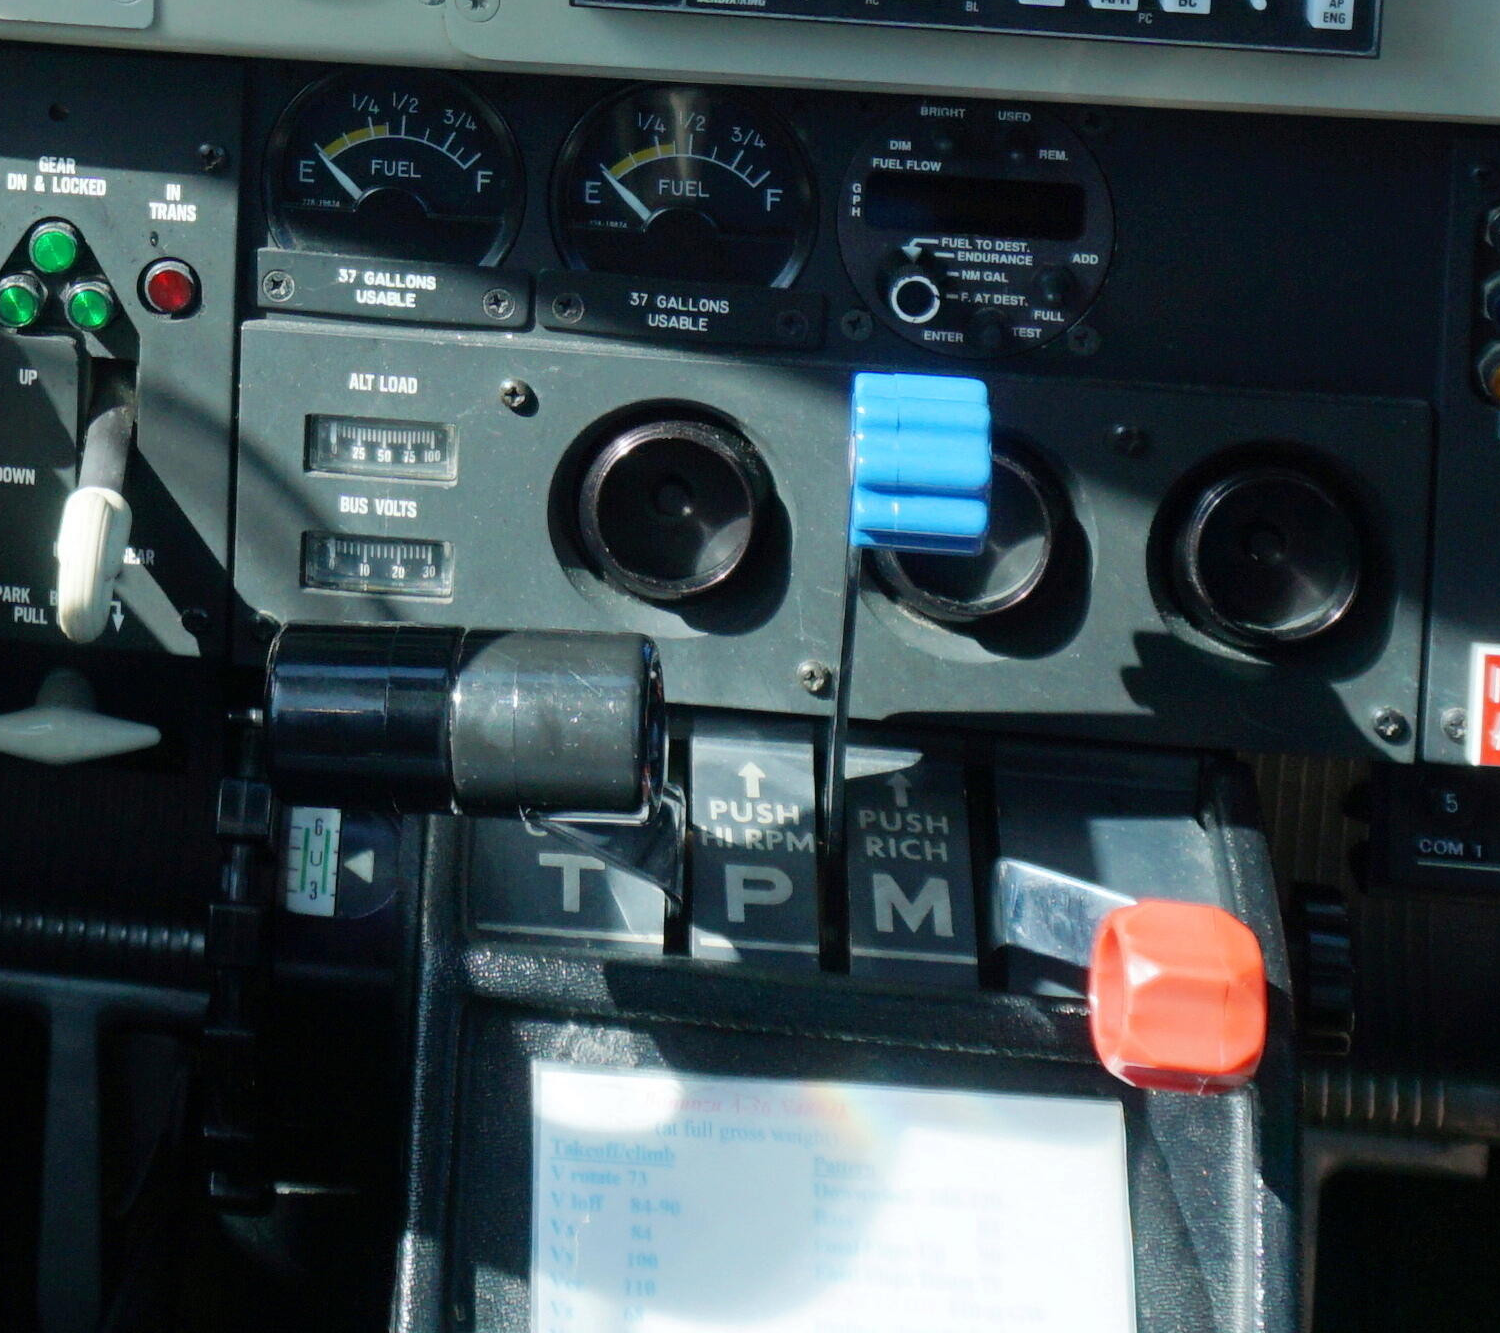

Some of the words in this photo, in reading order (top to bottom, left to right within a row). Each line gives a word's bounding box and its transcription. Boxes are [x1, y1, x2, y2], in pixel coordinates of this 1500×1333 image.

[39, 156, 75, 174] GEAR
[372, 160, 421, 177] FUEL
[8, 173, 27, 191] DN
[34, 175, 45, 191] &
[52, 177, 106, 196] LOCKED
[166, 184, 180, 200] IN
[659, 179, 709, 197] FUEL
[149, 202, 196, 221] TRANS
[338, 269, 357, 284] 37
[364, 271, 436, 290] GALLONS
[356, 290, 416, 307] USABLE
[629, 293, 649, 307] 37
[657, 295, 729, 313] GALLONS
[648, 314, 708, 331] USABLE
[20, 369, 37, 385] UP
[349, 373, 374, 390] ALT
[380, 375, 417, 394] LOAD
[340, 496, 368, 514] BUS
[374, 499, 417, 518] VOLTS
[710, 799, 798, 824] PUSH
[858, 809, 948, 834] PUSH
[866, 837, 948, 861] RICH
